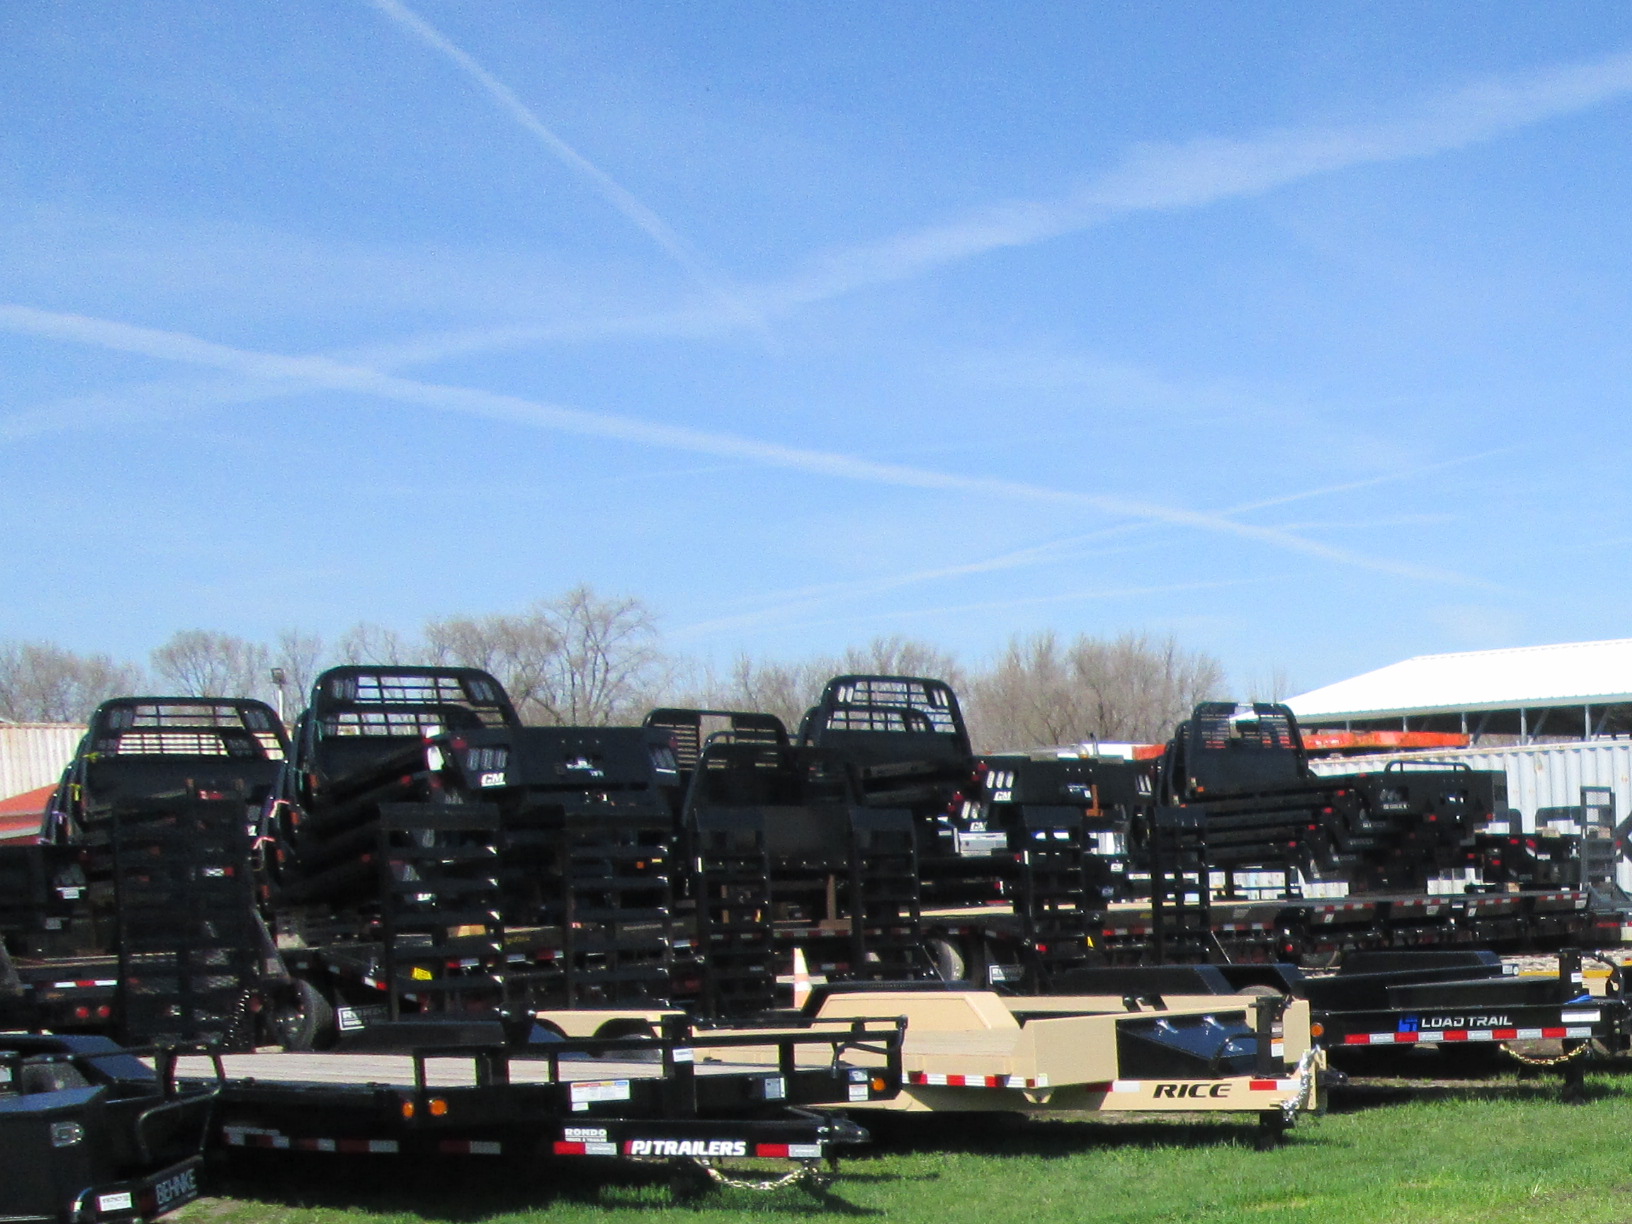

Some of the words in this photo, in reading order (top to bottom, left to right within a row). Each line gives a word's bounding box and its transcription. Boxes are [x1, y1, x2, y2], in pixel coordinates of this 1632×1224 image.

[1421, 1016, 1464, 1028] LOAD
[1468, 1015, 1513, 1027] TRAIL
[1153, 1084, 1232, 1099] RICE
